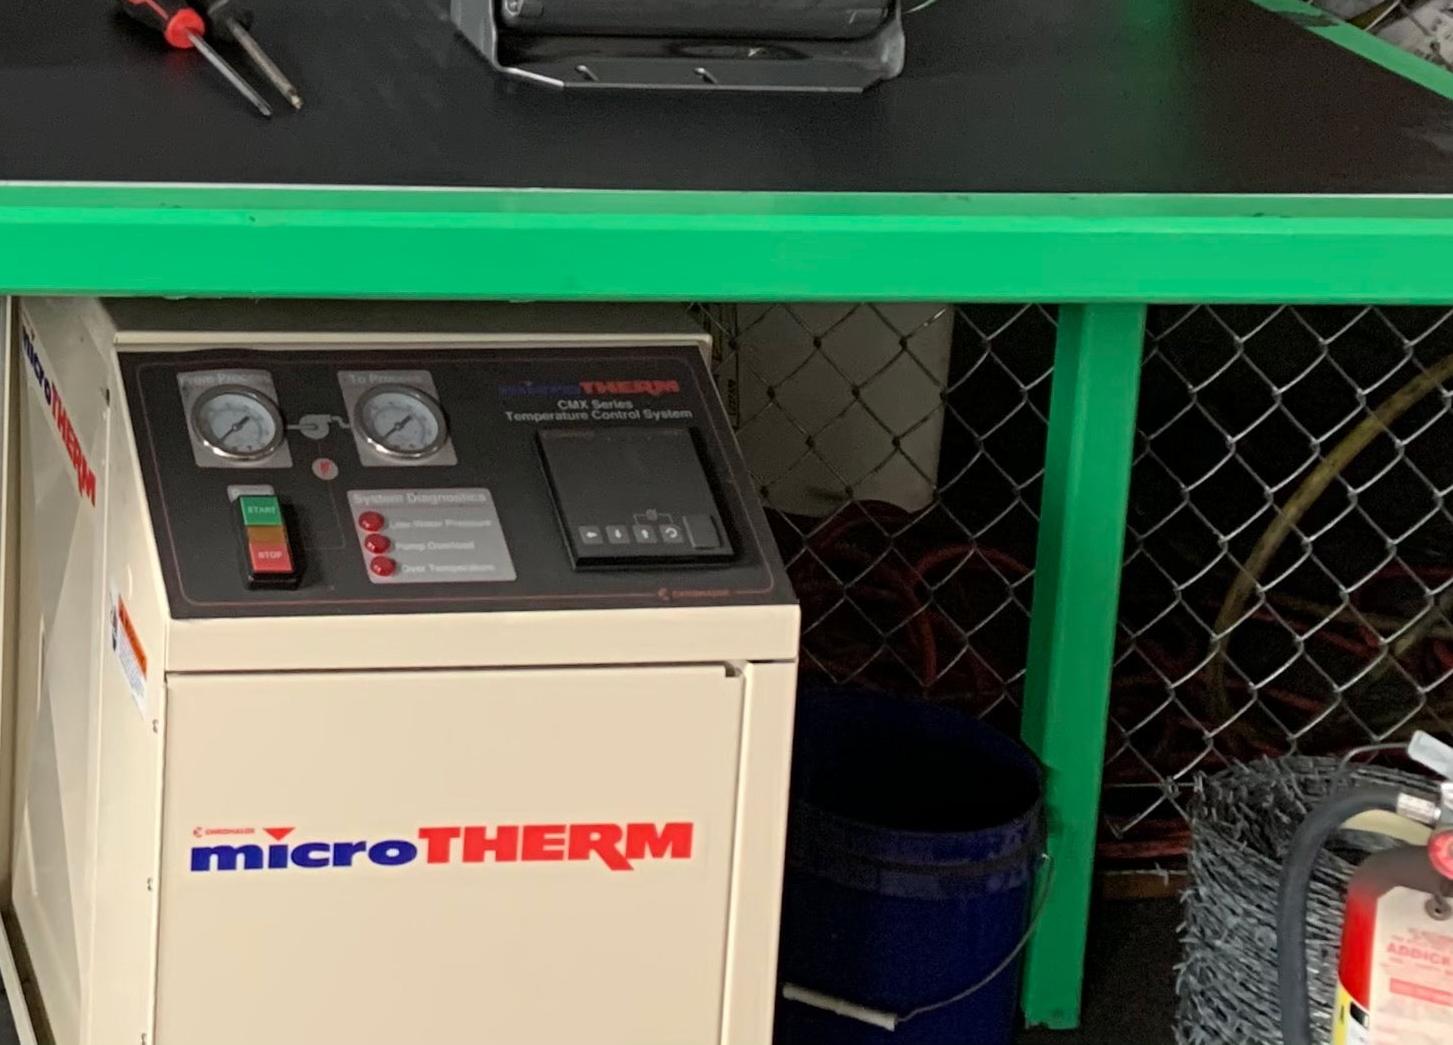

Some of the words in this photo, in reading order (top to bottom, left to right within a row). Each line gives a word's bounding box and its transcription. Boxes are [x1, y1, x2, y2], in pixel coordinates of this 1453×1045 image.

[557, 399, 588, 410] CMX
[591, 399, 633, 409] Series
[506, 411, 589, 423] Temperature
[591, 410, 641, 421] Control
[643, 410, 693, 422] System
[353, 493, 404, 506] System
[406, 493, 487, 505] Diagnostics
[247, 506, 276, 514] START
[258, 551, 283, 559] STOP
[191, 822, 694, 871] microTHERM
